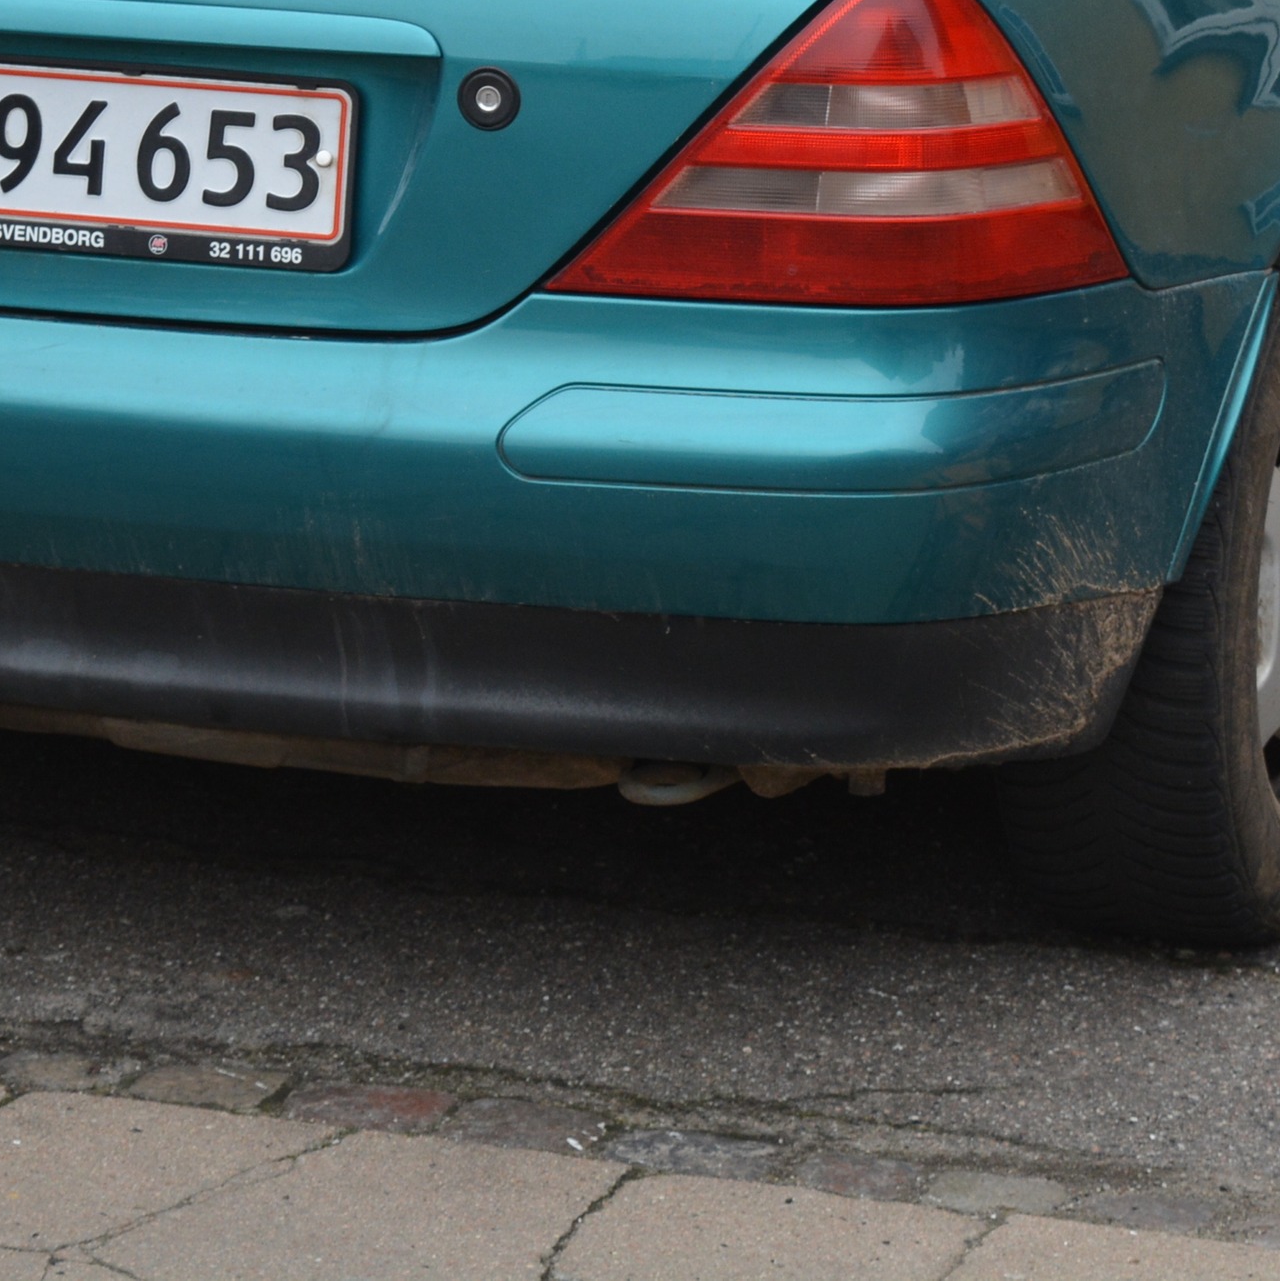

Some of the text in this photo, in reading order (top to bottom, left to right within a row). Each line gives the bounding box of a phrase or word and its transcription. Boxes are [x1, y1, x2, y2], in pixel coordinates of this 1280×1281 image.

[136, 101, 322, 212] 653
[208, 241, 303, 264] 32 111 696
